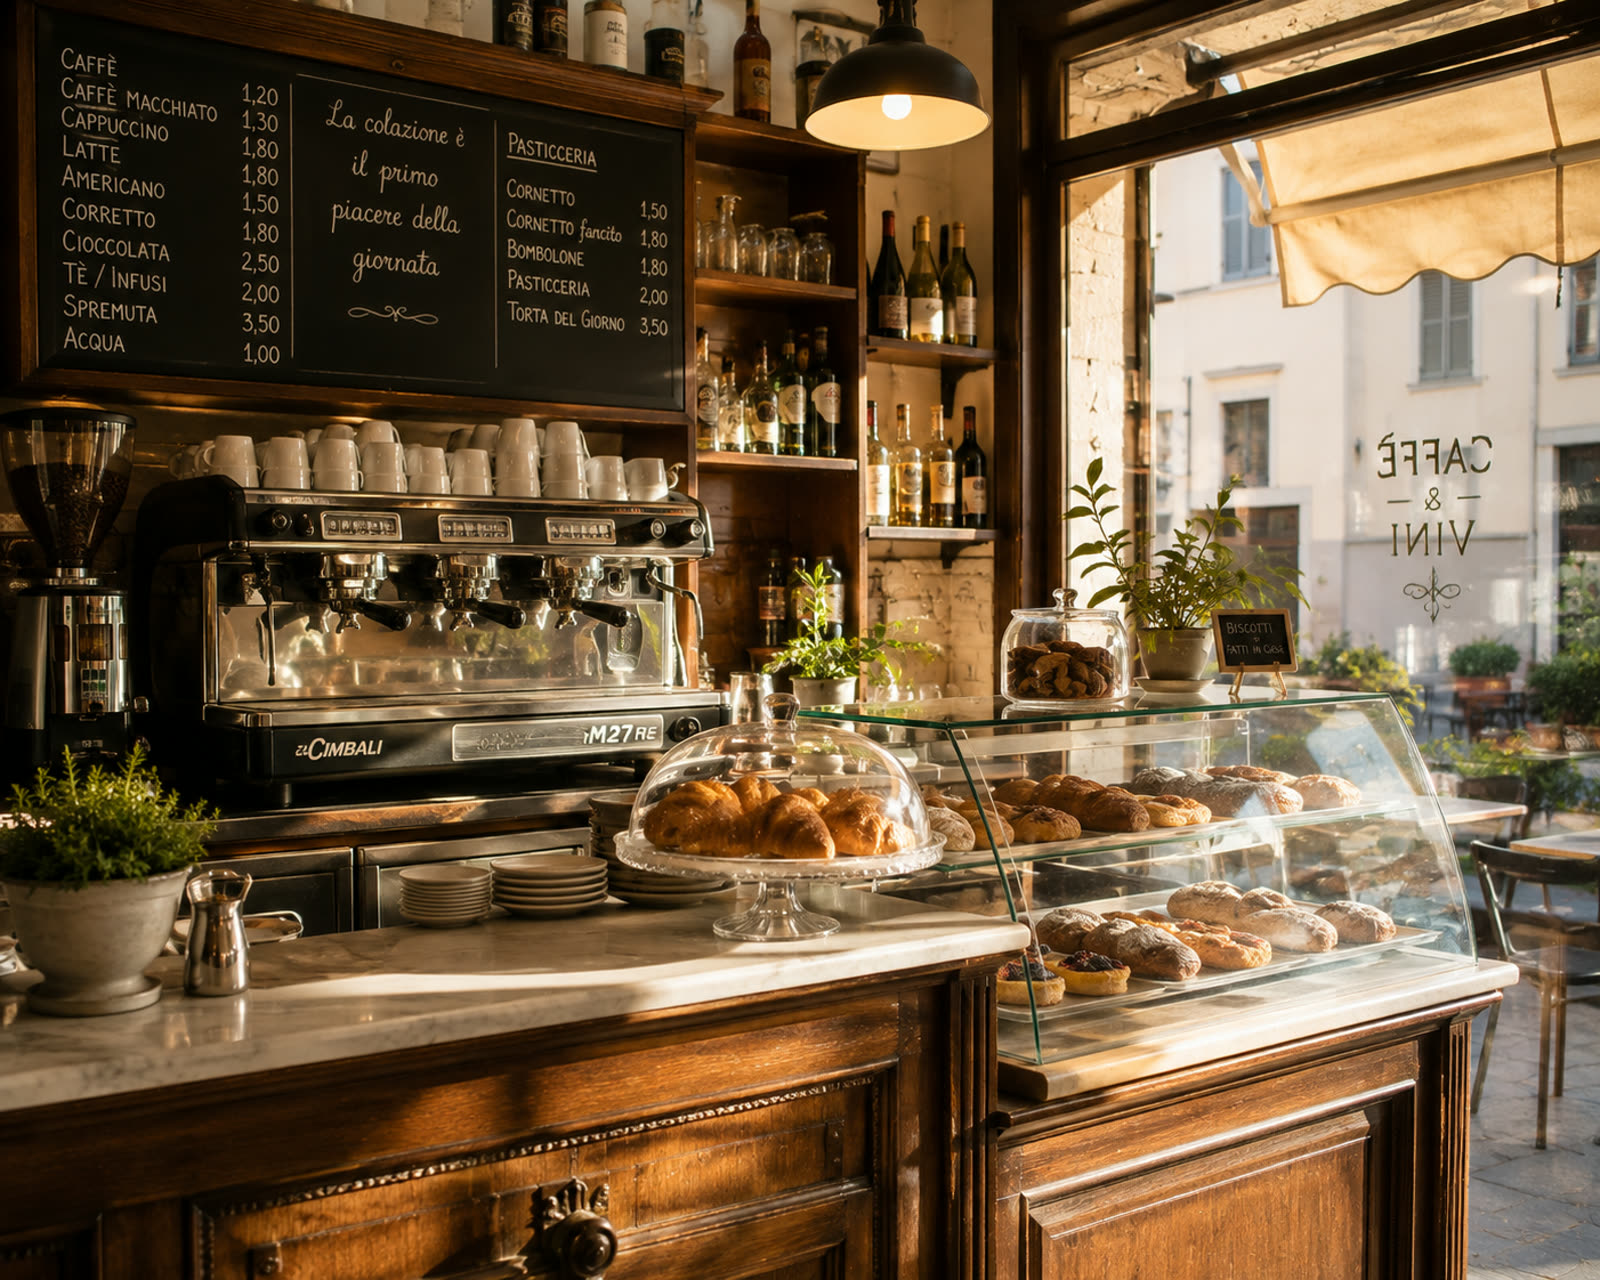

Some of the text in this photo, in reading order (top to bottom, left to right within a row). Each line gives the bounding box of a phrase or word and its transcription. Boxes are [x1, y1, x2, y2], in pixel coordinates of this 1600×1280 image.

[61, 48, 278, 106] CAFFÈ 1,20
[61, 76, 278, 132] CAFFÈ MACCHIATO 1,30
[326, 99, 464, 147] La colazione è
[62, 106, 278, 159] CAPPUCCINO 1,80
[508, 132, 597, 167] PASTICCERIA
[63, 134, 278, 186] LATTE 1,80
[352, 150, 438, 193] il primo
[62, 165, 279, 214] AMERICANO 1,50
[507, 179, 667, 220] CORNETTO 1,50
[63, 197, 279, 244] CORRETTO 1,80
[332, 200, 460, 233] piacere della
[507, 209, 574, 235] CORNETTO
[641, 229, 667, 248] 1,80
[63, 229, 279, 273] CIOCCOLATA 2,50
[353, 249, 440, 283] giornata
[507, 238, 667, 277] BOMBOLONE 1,80
[63, 261, 87, 285] TÈ
[112, 266, 166, 292] INFUSI
[242, 282, 279, 304] 2,00
[508, 269, 668, 306] PASTICCERIA 2,00
[64, 294, 279, 335] SPREMUTA 3,50
[507, 301, 668, 336] TORTA DEL GIORNO 3,50
[64, 326, 280, 364] ACQUA 1,00
[1226, 622, 1272, 634] BISCOTTI
